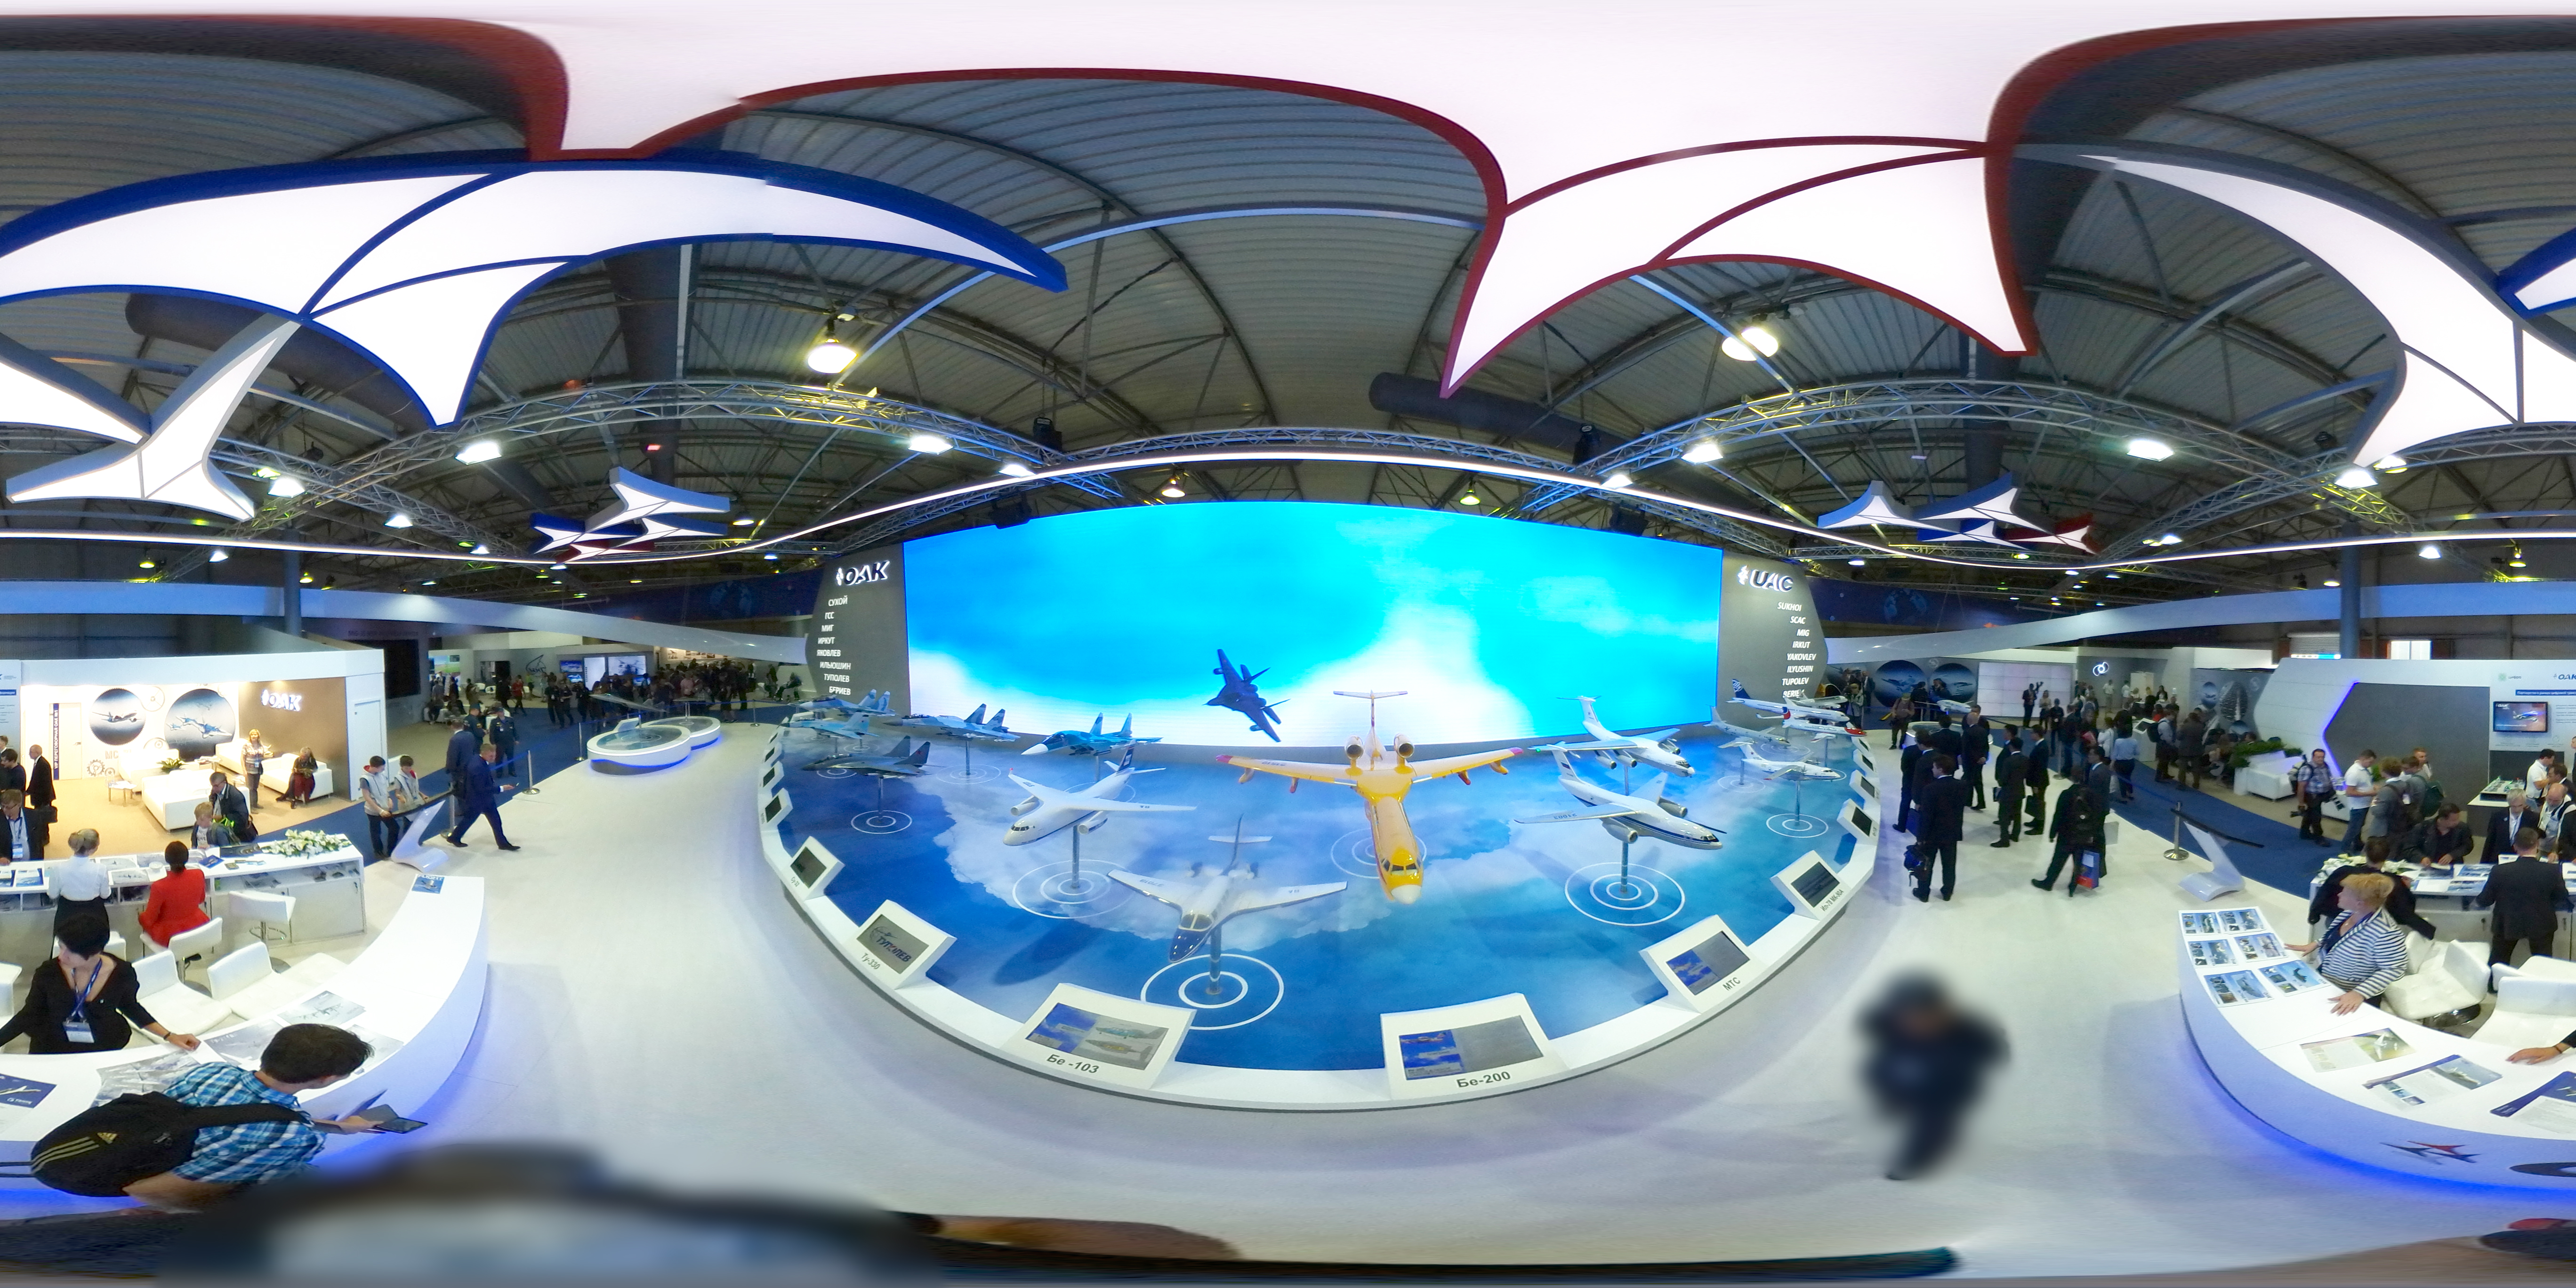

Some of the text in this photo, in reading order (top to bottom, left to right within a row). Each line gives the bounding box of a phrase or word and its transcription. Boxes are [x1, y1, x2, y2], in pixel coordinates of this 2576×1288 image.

[845, 560, 890, 586] ОАК
[1749, 569, 1794, 592] UAC
[828, 596, 847, 606] СУХОЙ
[1777, 602, 1802, 612] SUKHOI
[825, 612, 834, 620] ГСС
[1790, 616, 1806, 624] SCAC
[820, 661, 851, 670] ИЛЬЮШИН
[824, 674, 850, 683] ТУПОЛЕВ
[861, 952, 881, 970] Ту-330
[1723, 977, 1741, 991] МТС
[1046, 1054, 1100, 1073] Бе -103
[1456, 1071, 1511, 1088] Бе-200
